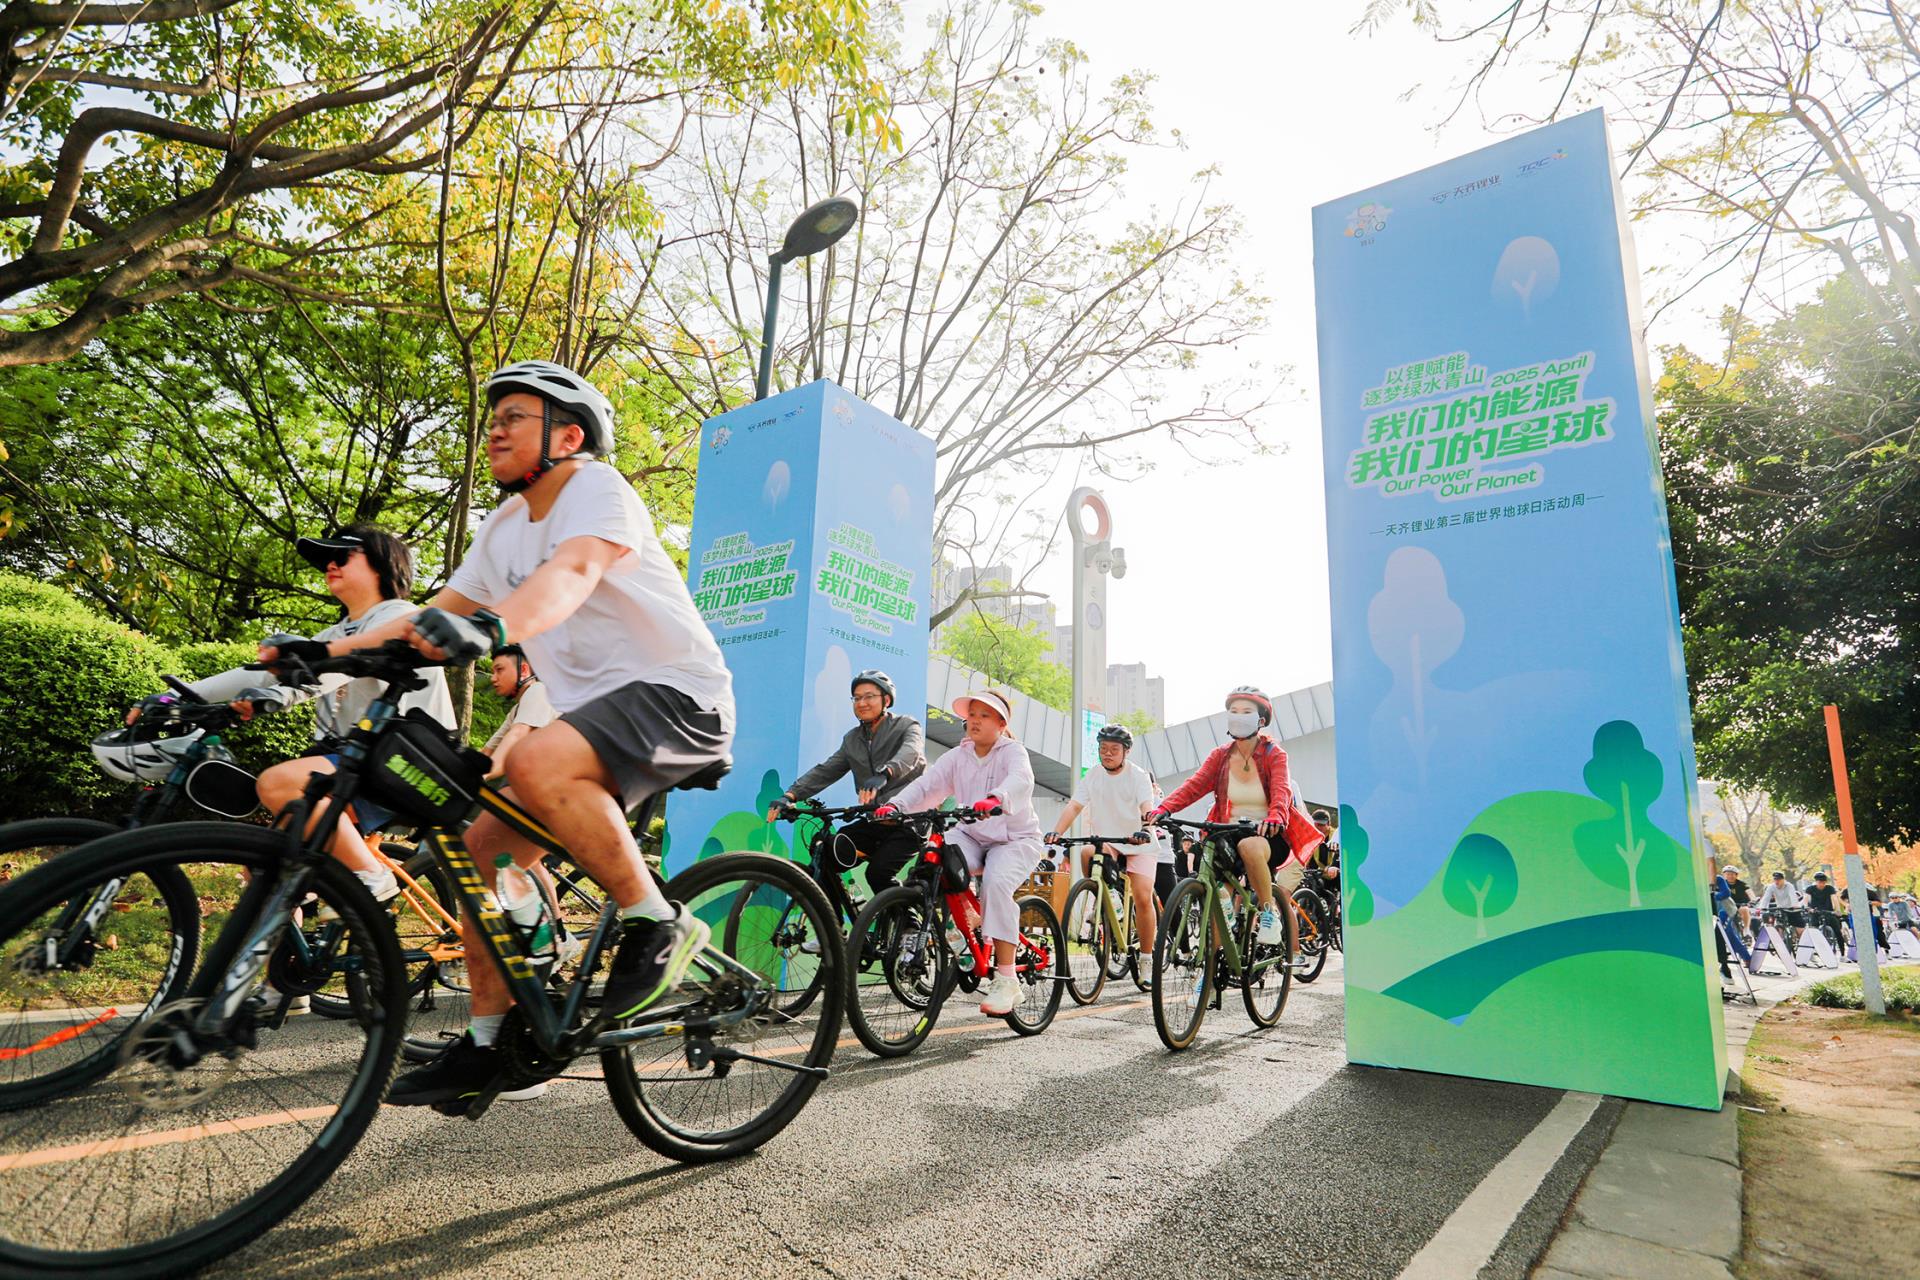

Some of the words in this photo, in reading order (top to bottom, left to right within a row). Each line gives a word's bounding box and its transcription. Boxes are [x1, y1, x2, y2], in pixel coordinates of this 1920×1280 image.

[1386, 353, 1466, 385] 以锂赋能
[1490, 367, 1539, 388] 2025
[1542, 354, 1588, 377] April
[1362, 367, 1485, 407] 逐梦绿水青山
[1368, 374, 1580, 444] 我们的能源
[1350, 403, 1609, 484] 我们的星球
[1384, 479, 1416, 494] Our
[1418, 467, 1474, 488] Power
[1440, 482, 1472, 497] Our
[1476, 469, 1537, 492] Planet
[701, 553, 787, 588] 我们的能源
[828, 551, 911, 596] 我们的能源
[716, 608, 741, 619] Power
[817, 571, 917, 622] 我们的星球
